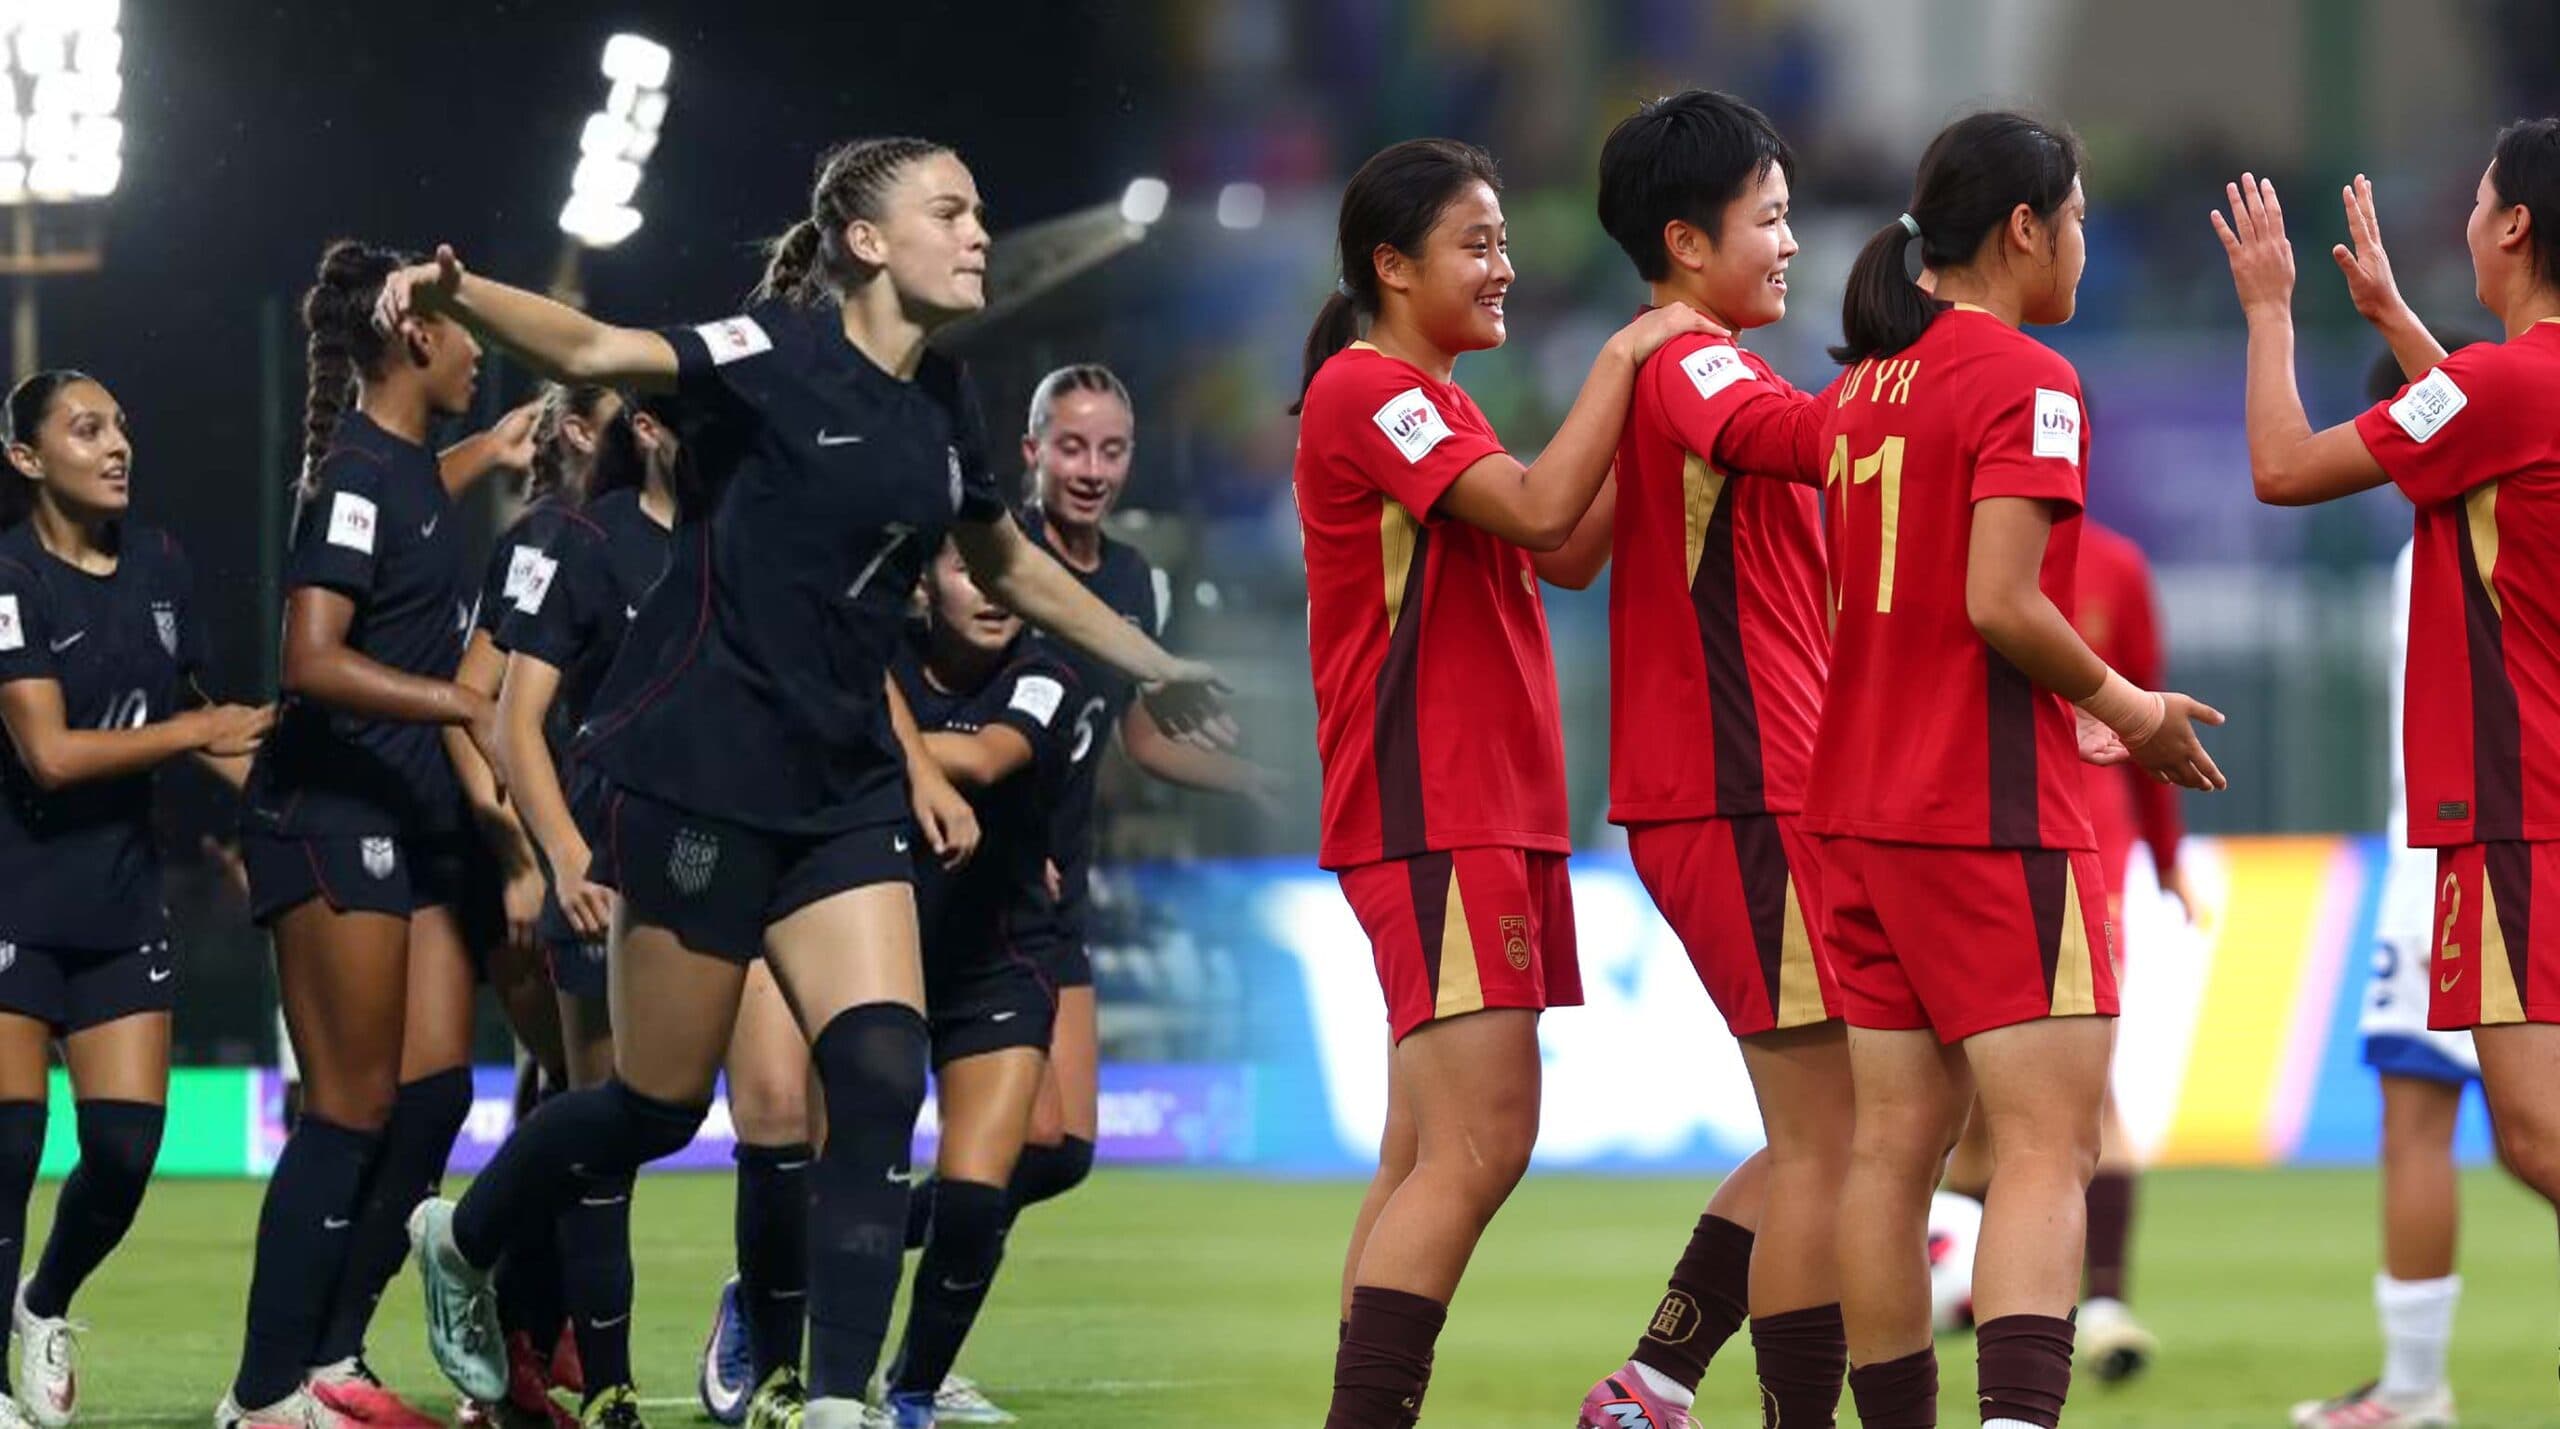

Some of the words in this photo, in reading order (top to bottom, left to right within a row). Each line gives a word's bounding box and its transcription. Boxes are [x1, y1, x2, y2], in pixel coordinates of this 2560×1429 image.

[1871, 359, 1920, 405] YX
[1393, 407, 1428, 437] U17
[846, 521, 918, 599] 7
[1827, 434, 1906, 613] 11
[2441, 871, 2461, 960] 2
